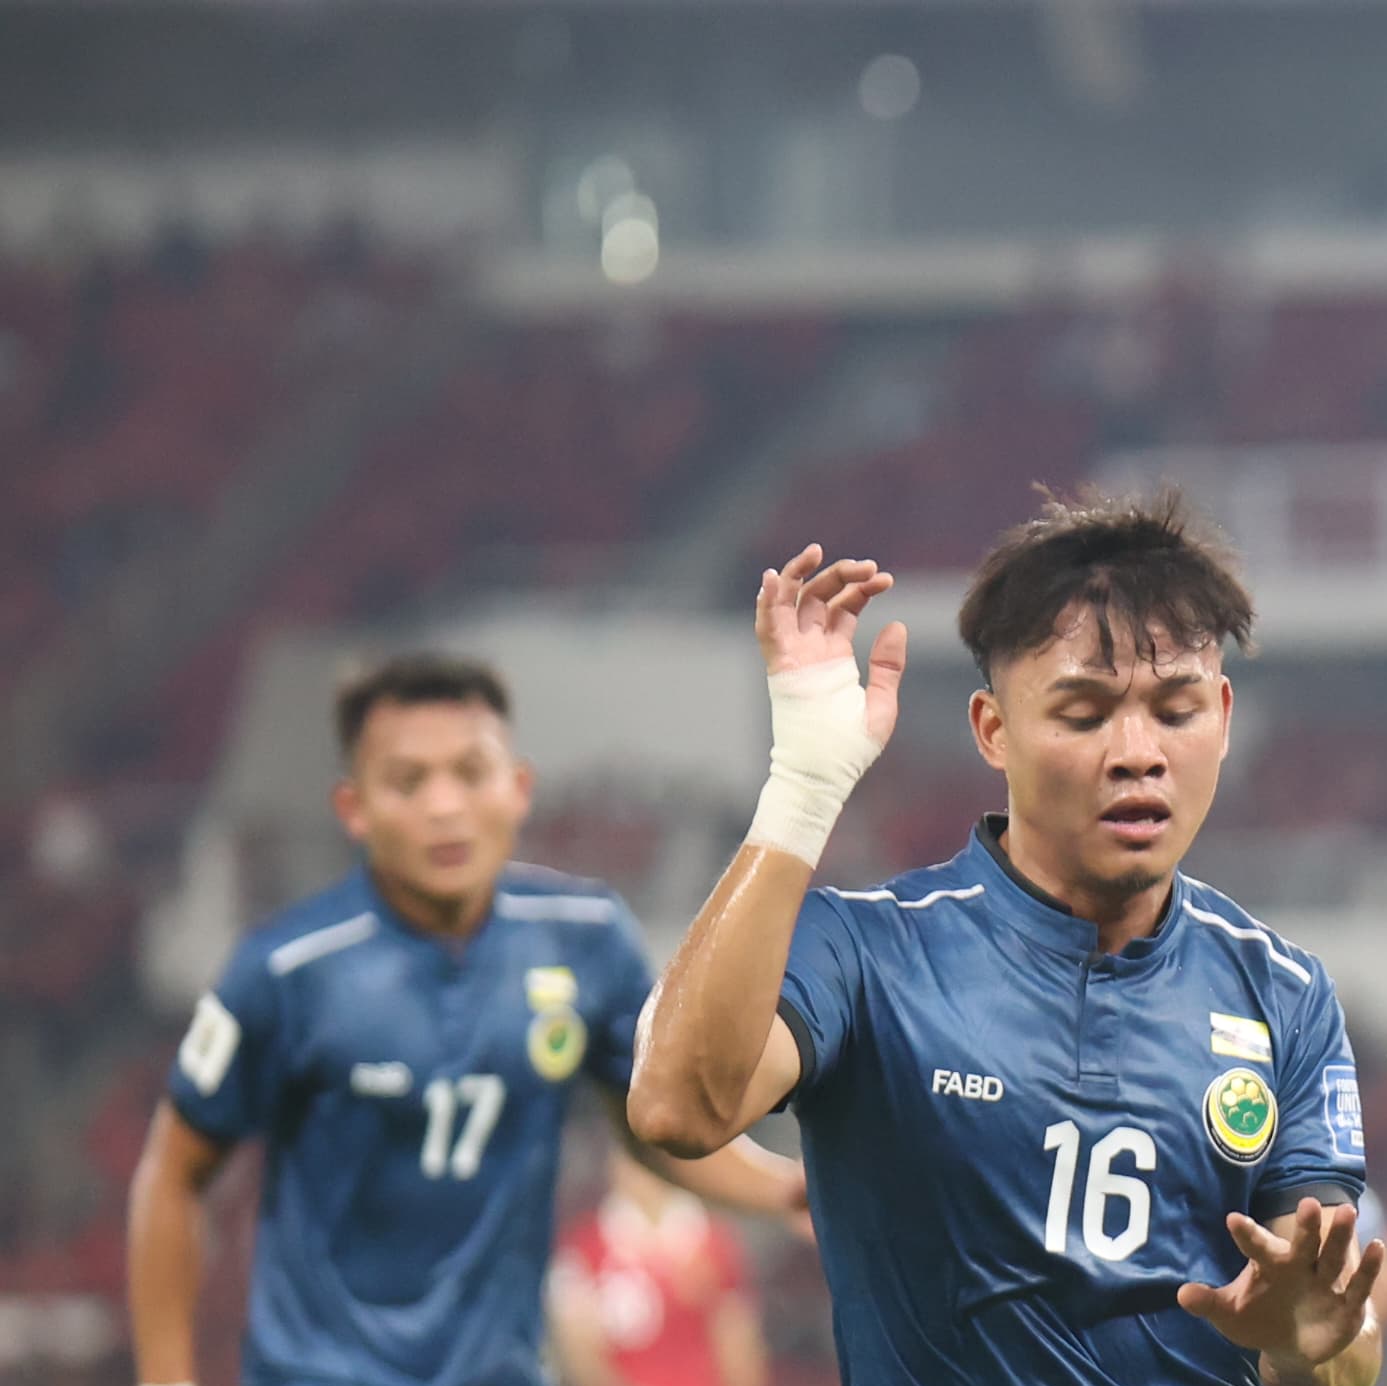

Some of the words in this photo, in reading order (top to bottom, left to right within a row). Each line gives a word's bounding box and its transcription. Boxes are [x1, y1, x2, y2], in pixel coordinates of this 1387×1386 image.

[420, 1073, 507, 1181] 17
[932, 1068, 1004, 1102] FABD
[1043, 1119, 1158, 1262] 16
